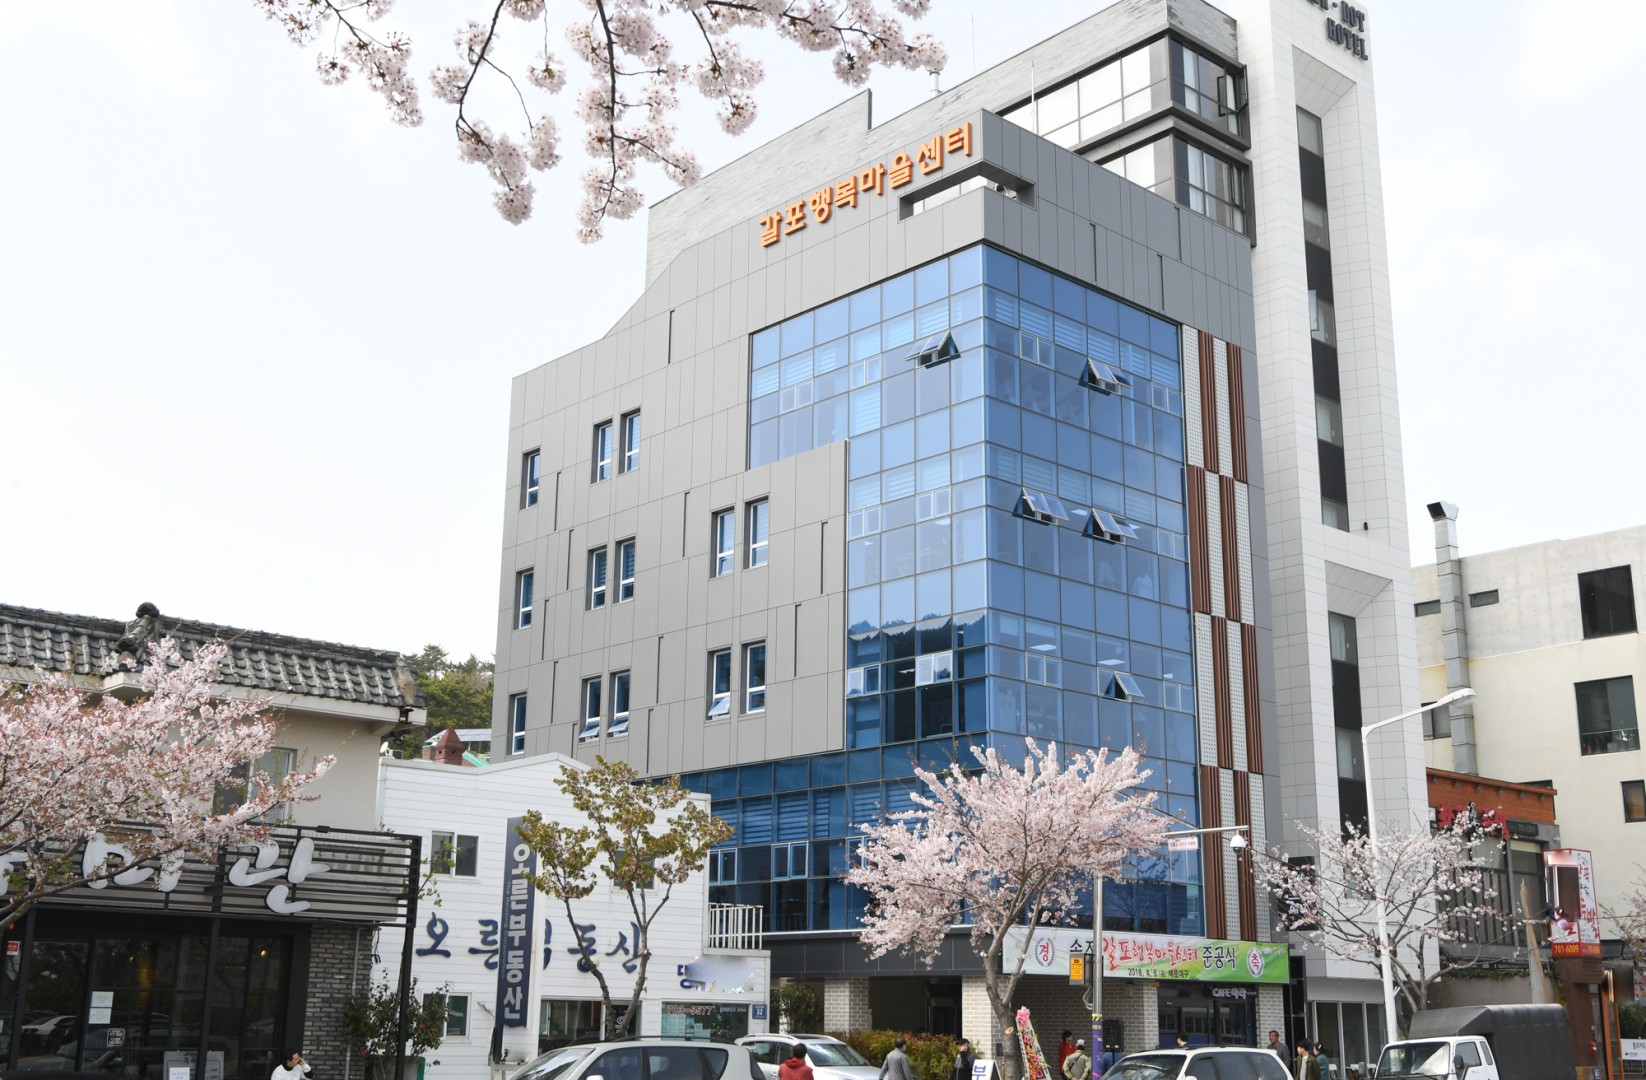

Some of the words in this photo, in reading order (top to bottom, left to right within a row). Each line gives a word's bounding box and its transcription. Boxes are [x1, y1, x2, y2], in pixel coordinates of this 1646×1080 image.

[1340, 0, 1365, 33] DOT
[1326, 16, 1369, 62] HOTEL
[758, 121, 974, 248] 갈포행복마을센터
[415, 911, 652, 974] 오른동산
[1039, 942, 1050, 963] 경
[1554, 944, 1580, 954] 701-6009
[1202, 945, 1236, 970] 준공식
[1250, 953, 1261, 970] 축
[667, 1004, 713, 1016] 703-5577
